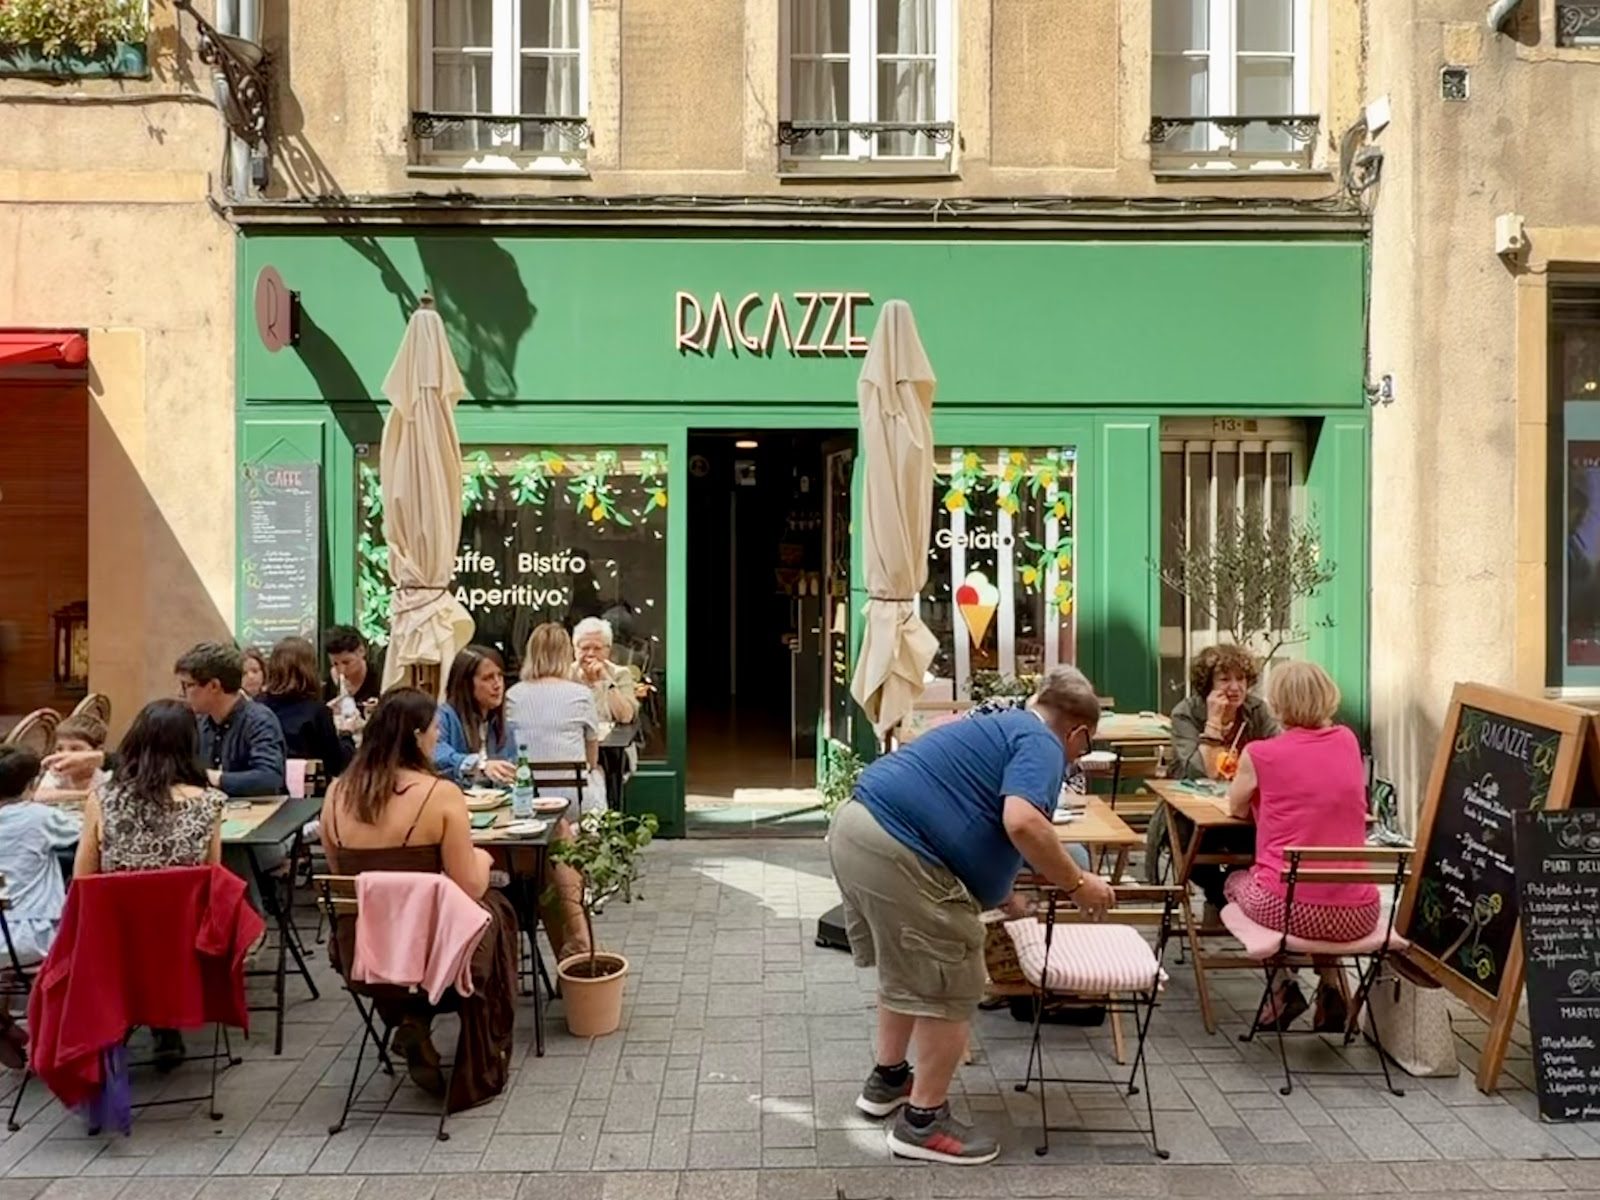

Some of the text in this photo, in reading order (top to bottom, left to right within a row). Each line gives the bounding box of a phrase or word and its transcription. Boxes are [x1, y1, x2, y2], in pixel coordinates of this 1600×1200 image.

[675, 291, 871, 352] RAGAZZE
[935, 528, 1015, 549] Gelato
[453, 551, 586, 573] affe Bistro
[455, 585, 562, 611] Aperitivo
[1480, 720, 1533, 760] RAGAZZE
